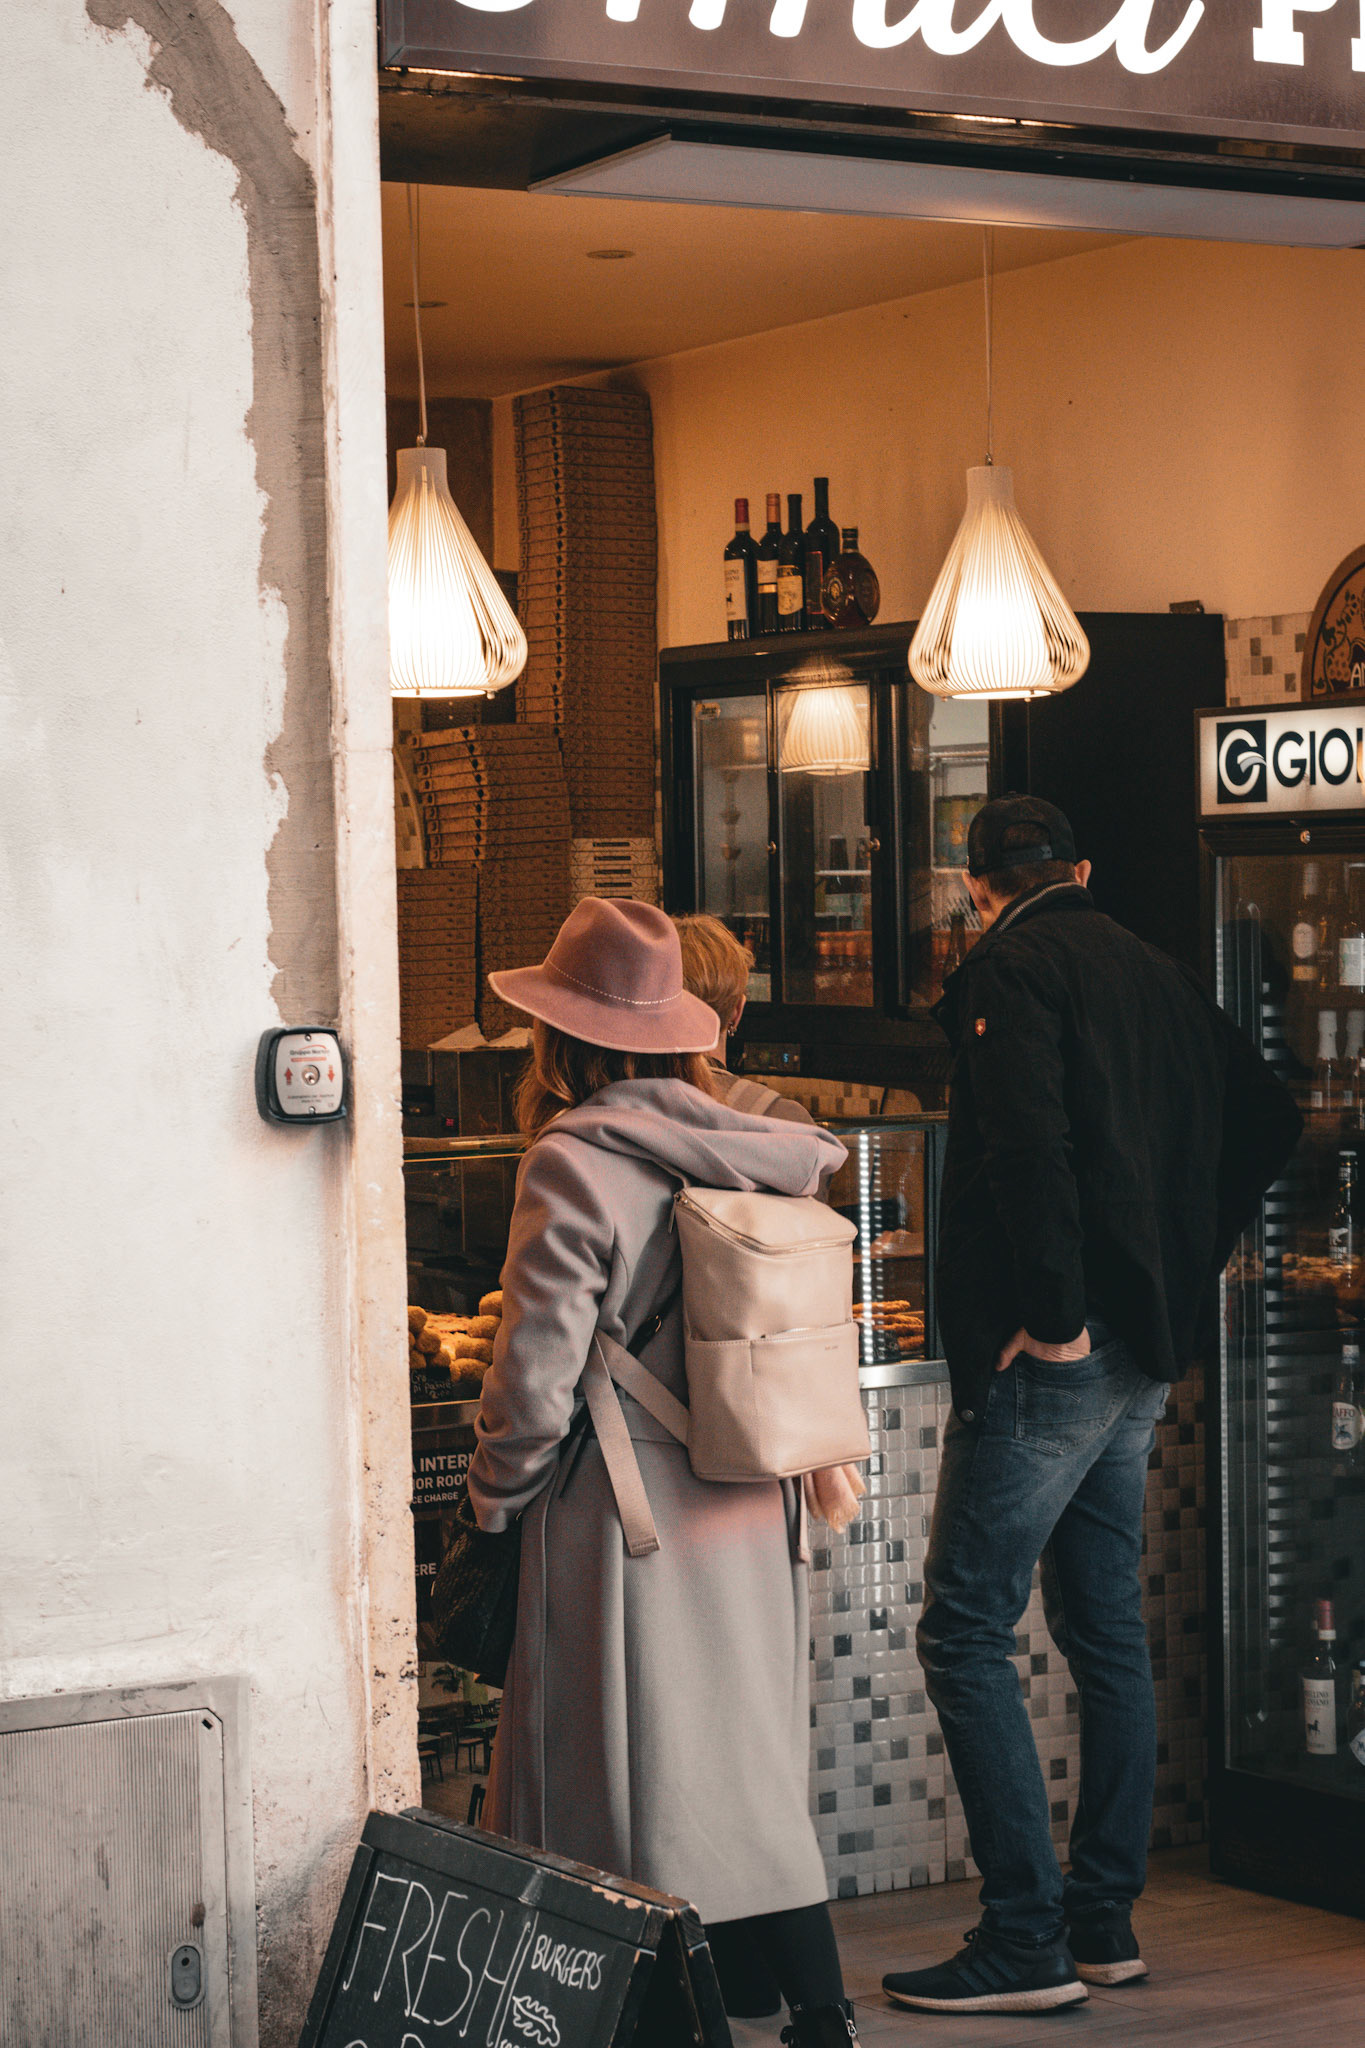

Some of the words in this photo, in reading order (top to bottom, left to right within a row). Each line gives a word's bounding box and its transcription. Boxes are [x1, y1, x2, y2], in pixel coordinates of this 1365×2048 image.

[424, 1491, 459, 1503] CHARGE
[343, 1871, 531, 2047] FRESH
[530, 1934, 606, 1991] BURGERS
